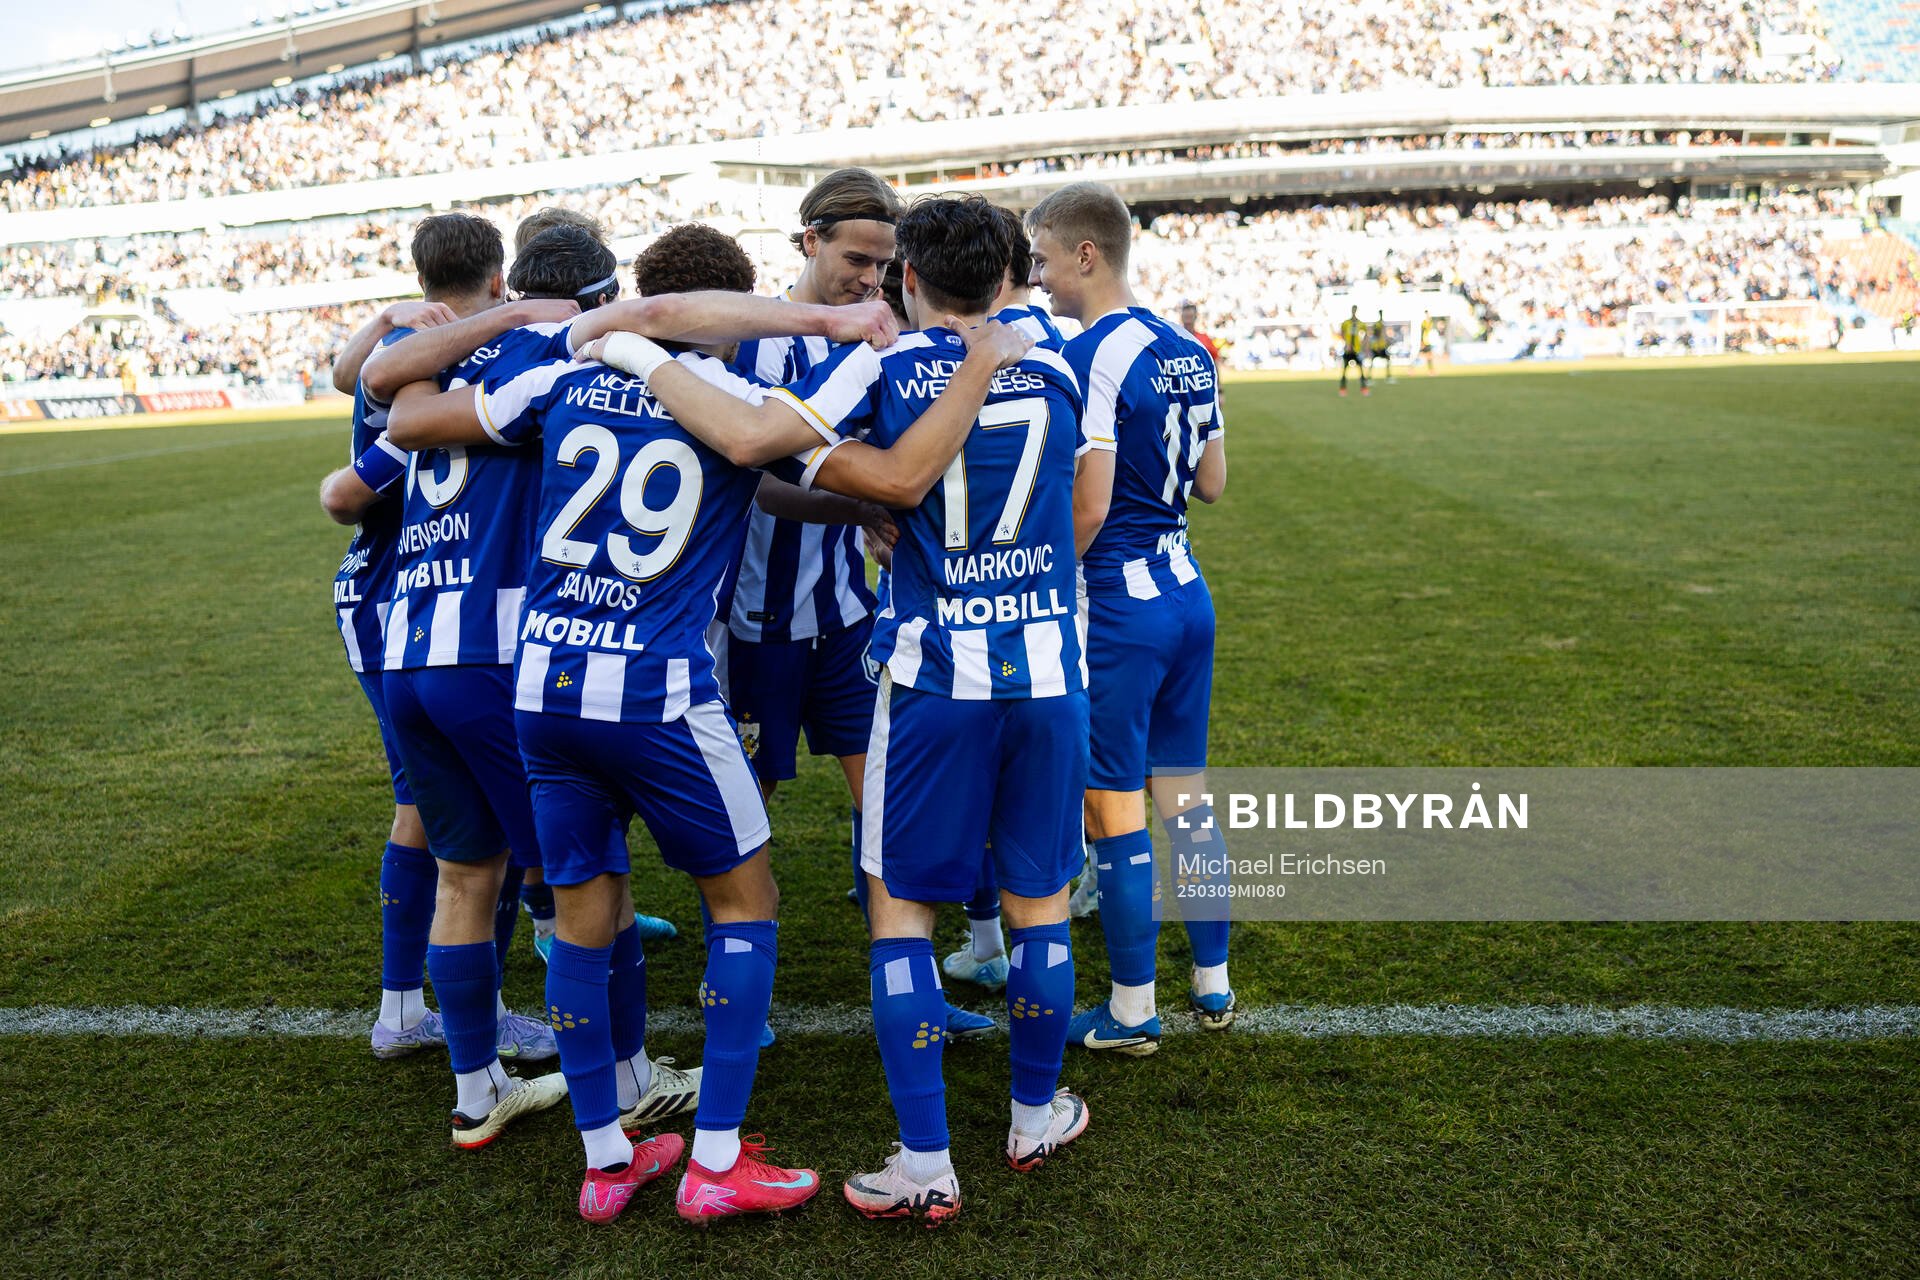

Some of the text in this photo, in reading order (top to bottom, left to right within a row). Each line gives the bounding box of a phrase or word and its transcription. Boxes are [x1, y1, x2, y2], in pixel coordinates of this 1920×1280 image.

[565, 386, 674, 421] WELLNE
[589, 373, 654, 397] NOR
[943, 397, 1050, 552] 17
[1162, 401, 1215, 506] 15
[541, 423, 703, 583] 29
[944, 543, 1053, 586] MARKOVIC
[557, 571, 641, 611] SANTOS
[936, 588, 1069, 627] MOBILL
[520, 609, 644, 651] MOBILL
